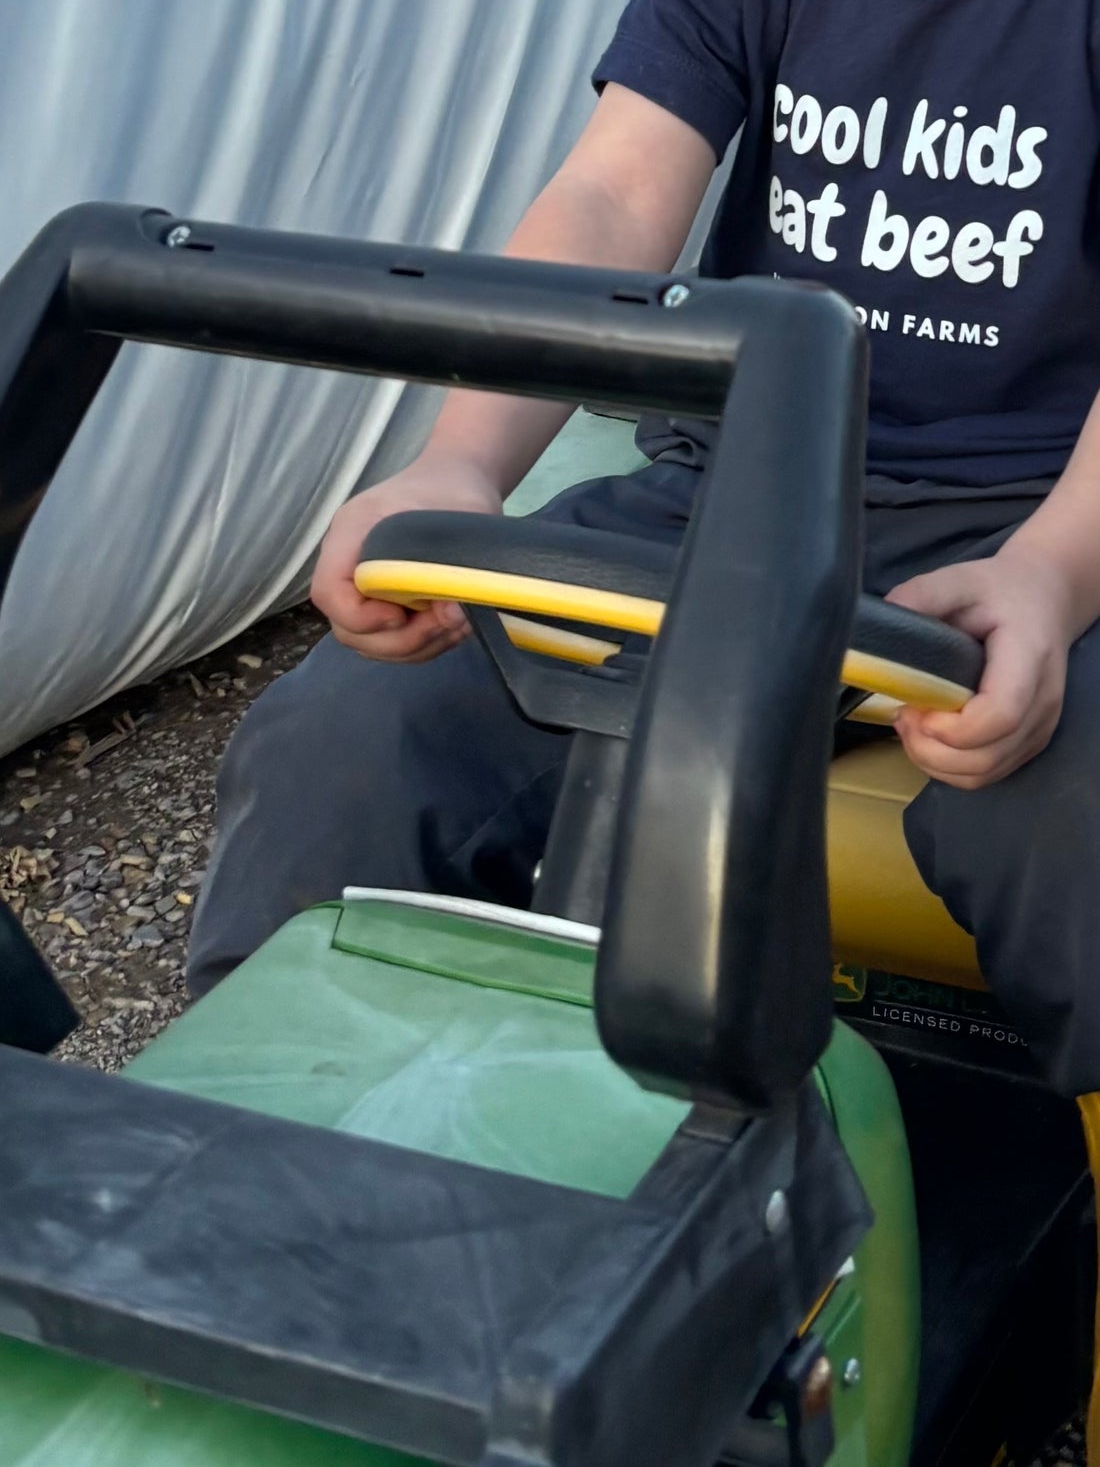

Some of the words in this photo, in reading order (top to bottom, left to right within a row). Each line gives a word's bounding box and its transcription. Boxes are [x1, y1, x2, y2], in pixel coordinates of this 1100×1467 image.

[773, 83, 888, 169] cool
[902, 98, 1048, 189] kids
[769, 175, 846, 263] eat
[860, 189, 1044, 288] beef
[902, 314, 999, 347] FARMS
[872, 1006, 961, 1032] LICENSED
